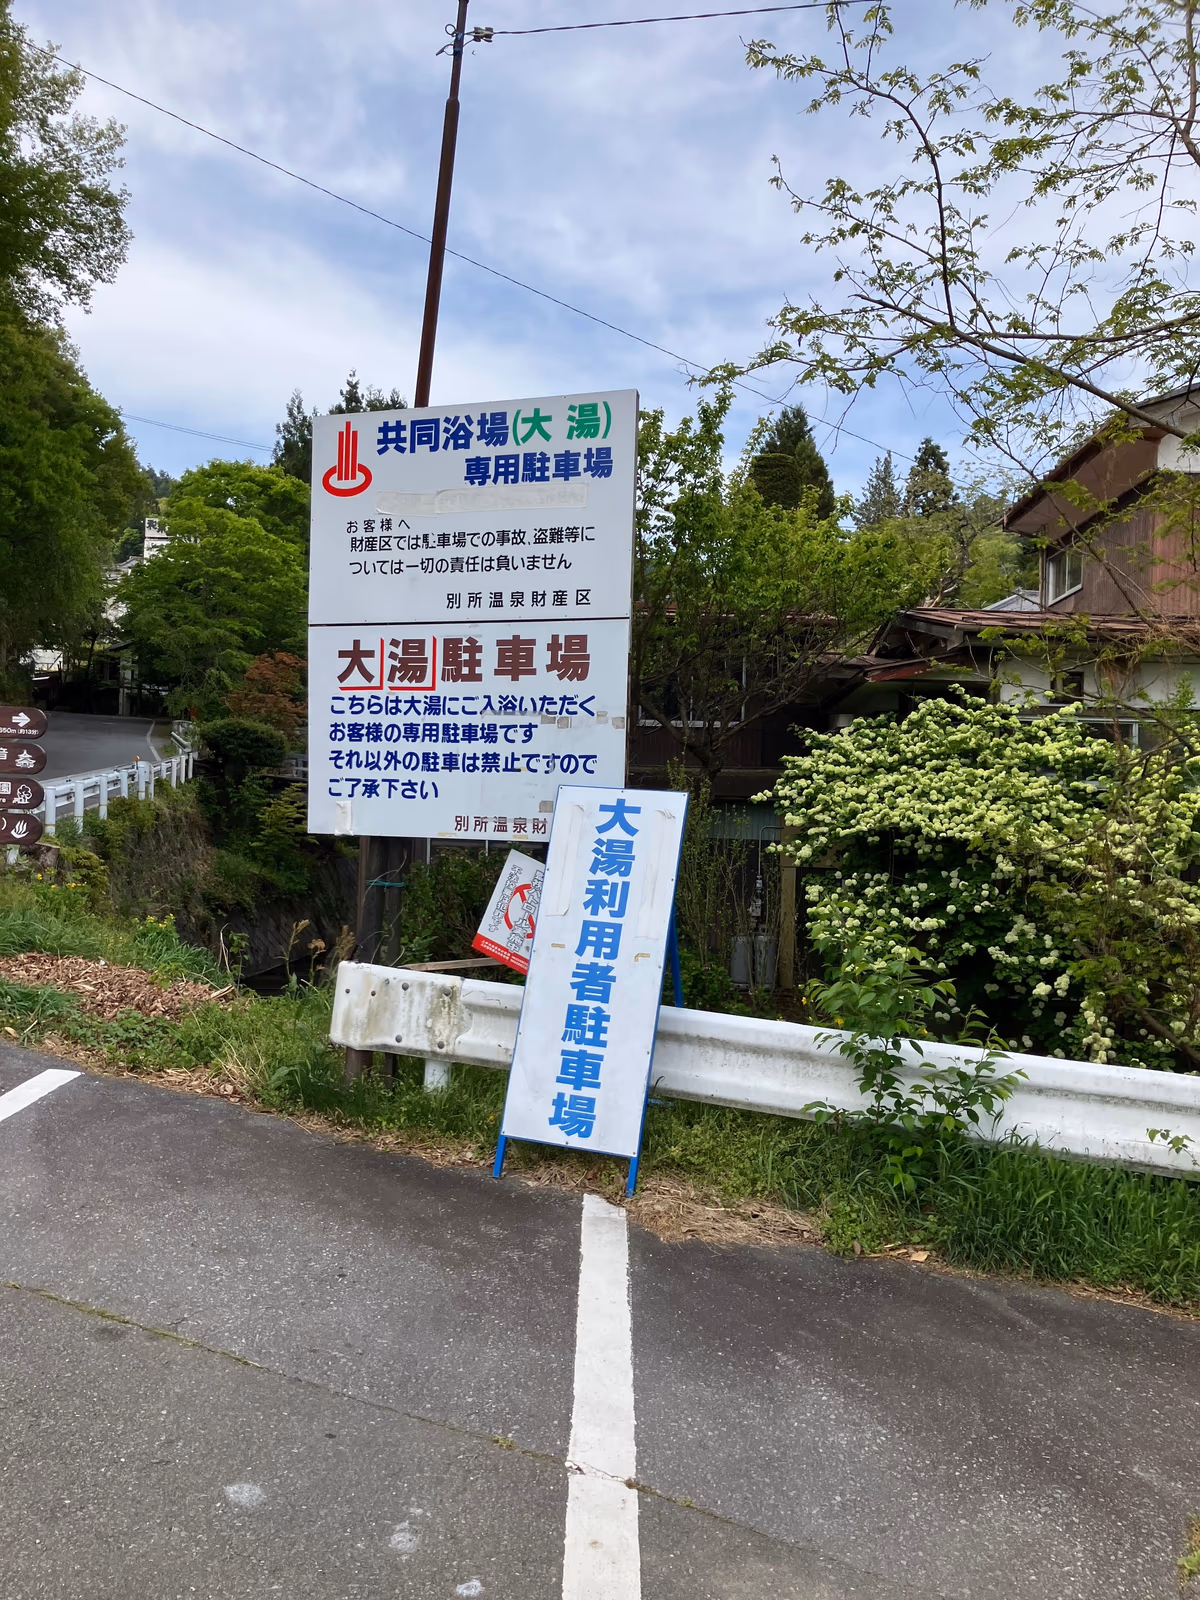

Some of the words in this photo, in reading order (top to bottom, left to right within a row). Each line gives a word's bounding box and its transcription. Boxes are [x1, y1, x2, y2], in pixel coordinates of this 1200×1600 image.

[464, 446, 614, 486] 専用駐車場
[346, 518, 410, 534] お客様へ
[349, 553, 572, 576] ついては一切の責任は負いません
[446, 588, 592, 609] 別所温泉財産区
[337, 634, 591, 684] 大湯駐車場
[329, 694, 597, 717] こちらは大湯にご入浴いただく
[328, 722, 539, 745] お客様の専用駐車場です
[328, 749, 598, 775] それ以外の駐車は禁止ですので
[328, 777, 439, 800] ご了承下さい
[547, 798, 642, 1139] 大湯利用者駐車場
